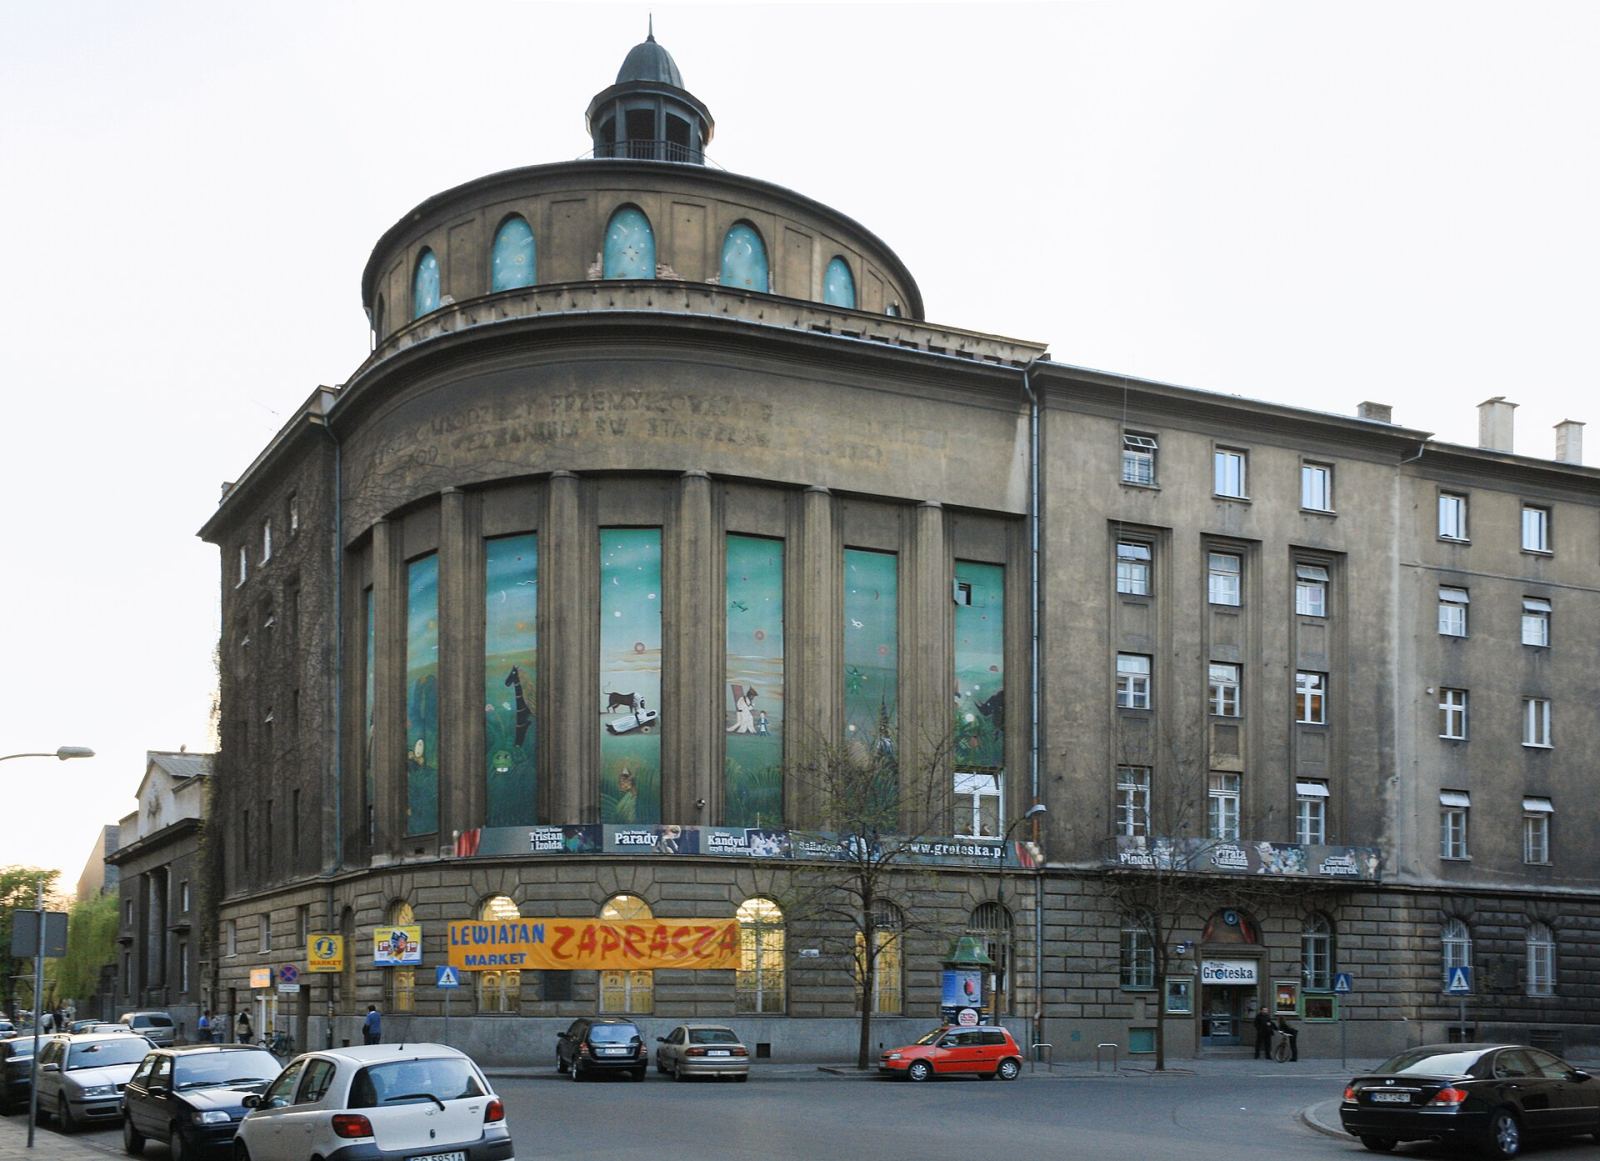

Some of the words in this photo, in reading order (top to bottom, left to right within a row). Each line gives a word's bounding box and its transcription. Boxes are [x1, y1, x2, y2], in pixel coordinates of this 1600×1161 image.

[529, 831, 563, 841] Tristan
[614, 831, 659, 847] Parady
[707, 835, 745, 847] Kandyd
[535, 840, 563, 850] Izolda
[450, 923, 545, 946] LEWIATAN
[550, 922, 738, 961] ZAPRASZA
[464, 953, 528, 966] MARKET
[1203, 966, 1253, 979] Groteska
